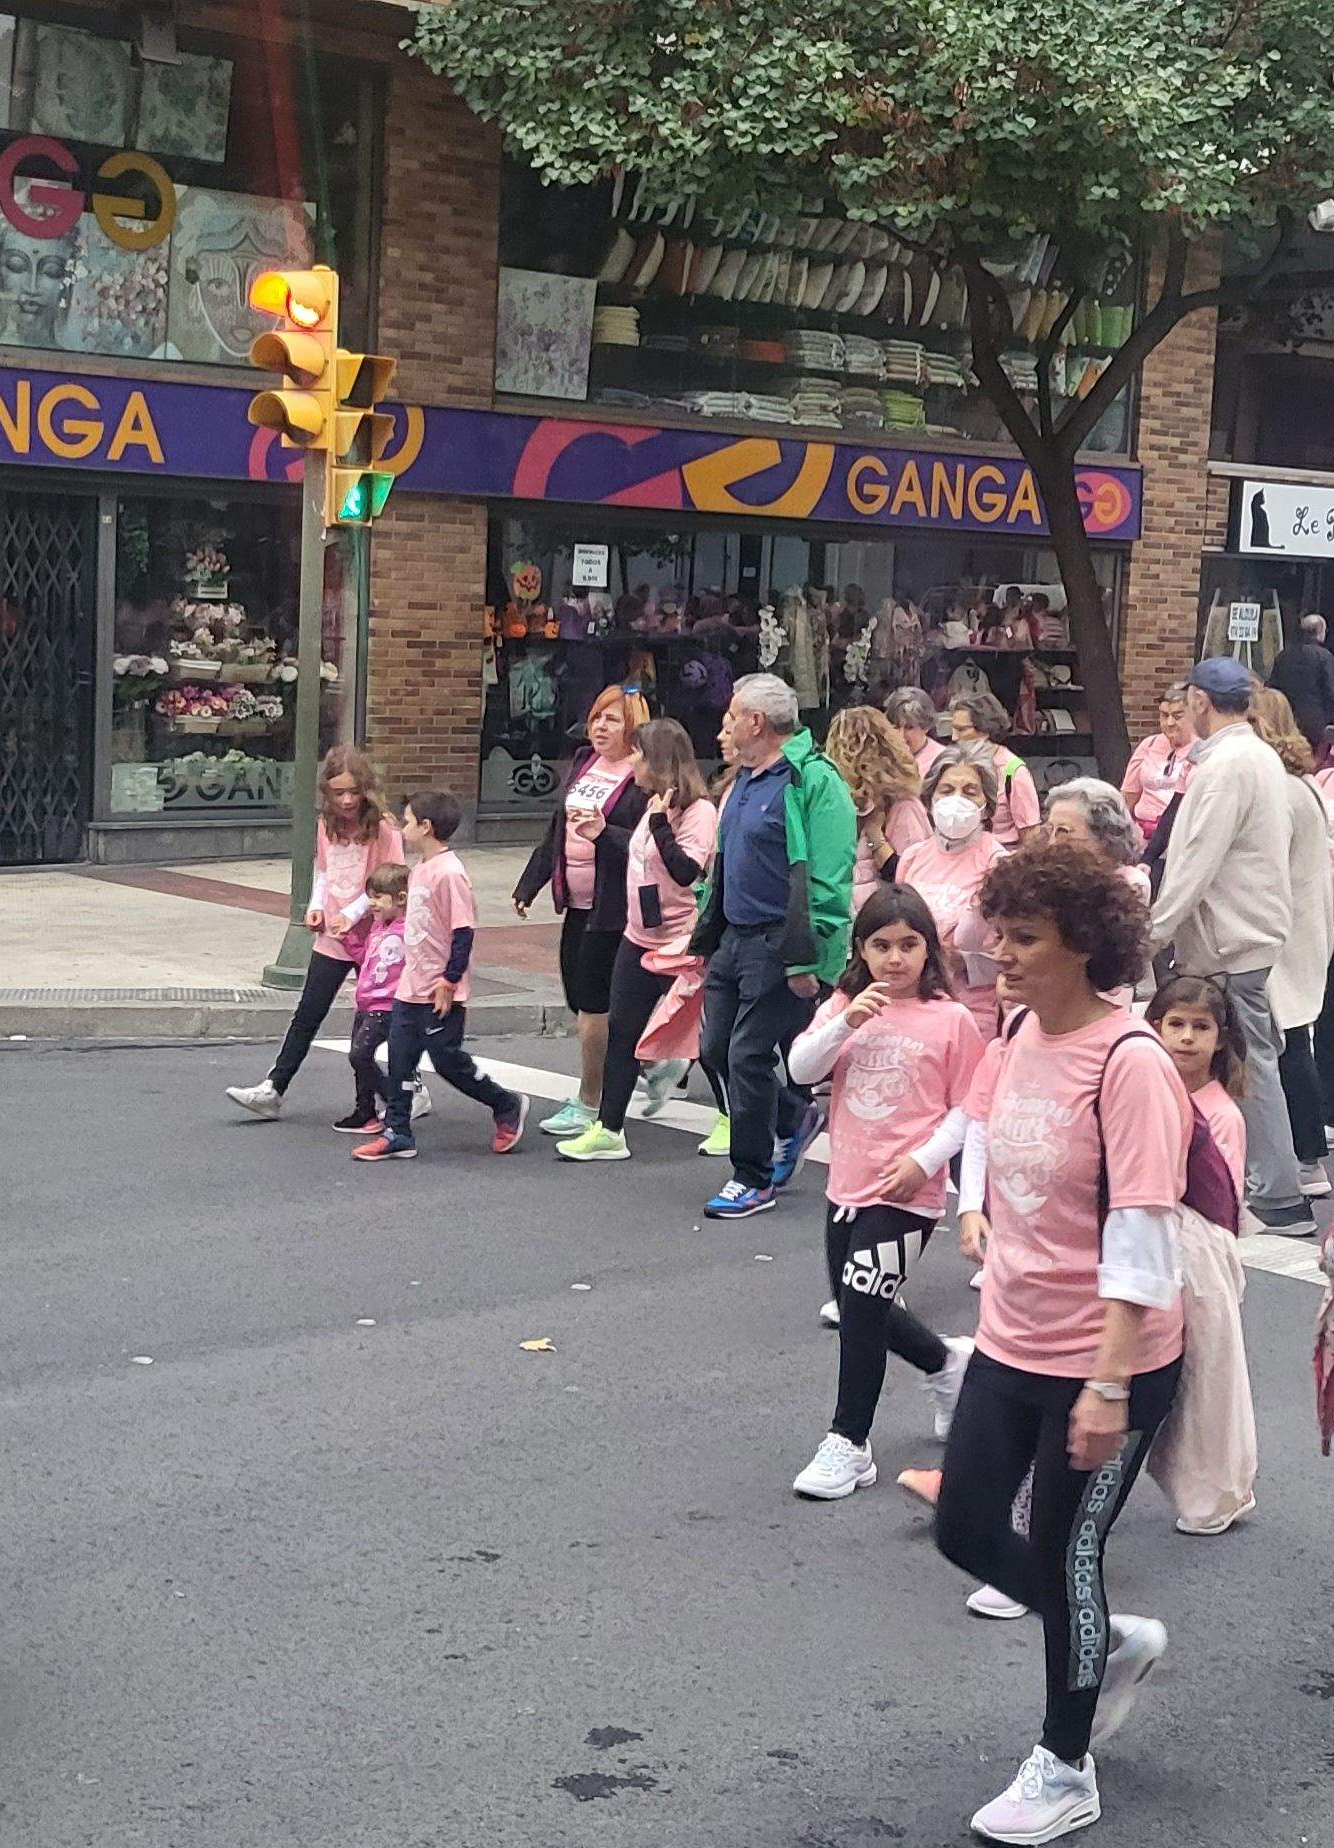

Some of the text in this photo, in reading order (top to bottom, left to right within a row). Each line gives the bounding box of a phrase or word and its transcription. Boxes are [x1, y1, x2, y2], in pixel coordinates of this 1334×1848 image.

[847, 455, 1042, 525] GANGA
[1292, 507, 1320, 536] Le
[1075, 1519, 1099, 1601] adidas
[1077, 1607, 1101, 1688] adidas
